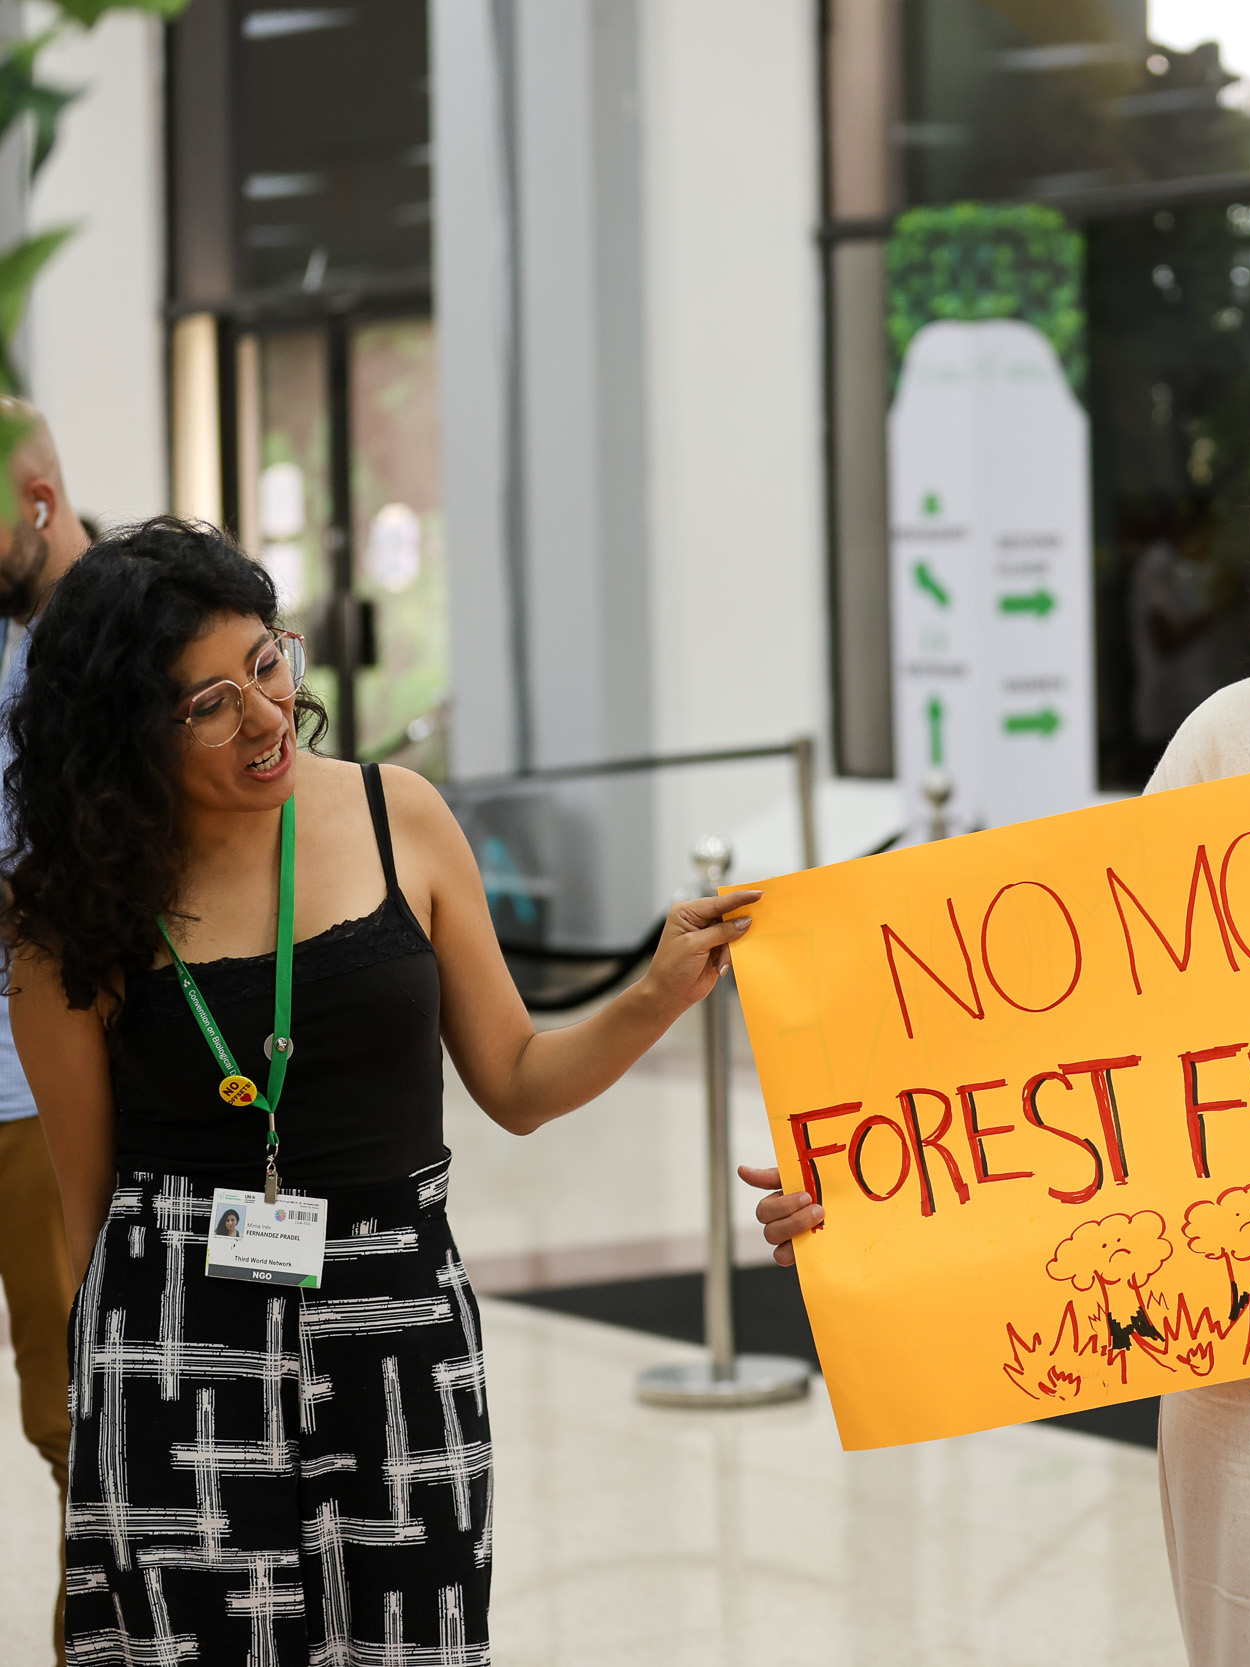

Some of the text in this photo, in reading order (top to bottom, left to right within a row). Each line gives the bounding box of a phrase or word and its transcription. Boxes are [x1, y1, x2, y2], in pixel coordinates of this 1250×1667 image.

[881, 881, 1082, 1039] NO
[188, 989, 234, 1070] Convention on Biological
[222, 1082, 239, 1096] NO
[790, 1054, 1142, 1233] FOREST
[246, 1230, 279, 1239] FERNANDEZ
[279, 1233, 301, 1241] PRADEL
[234, 1255, 292, 1267] Third World Network
[252, 1271, 272, 1280] NGO
